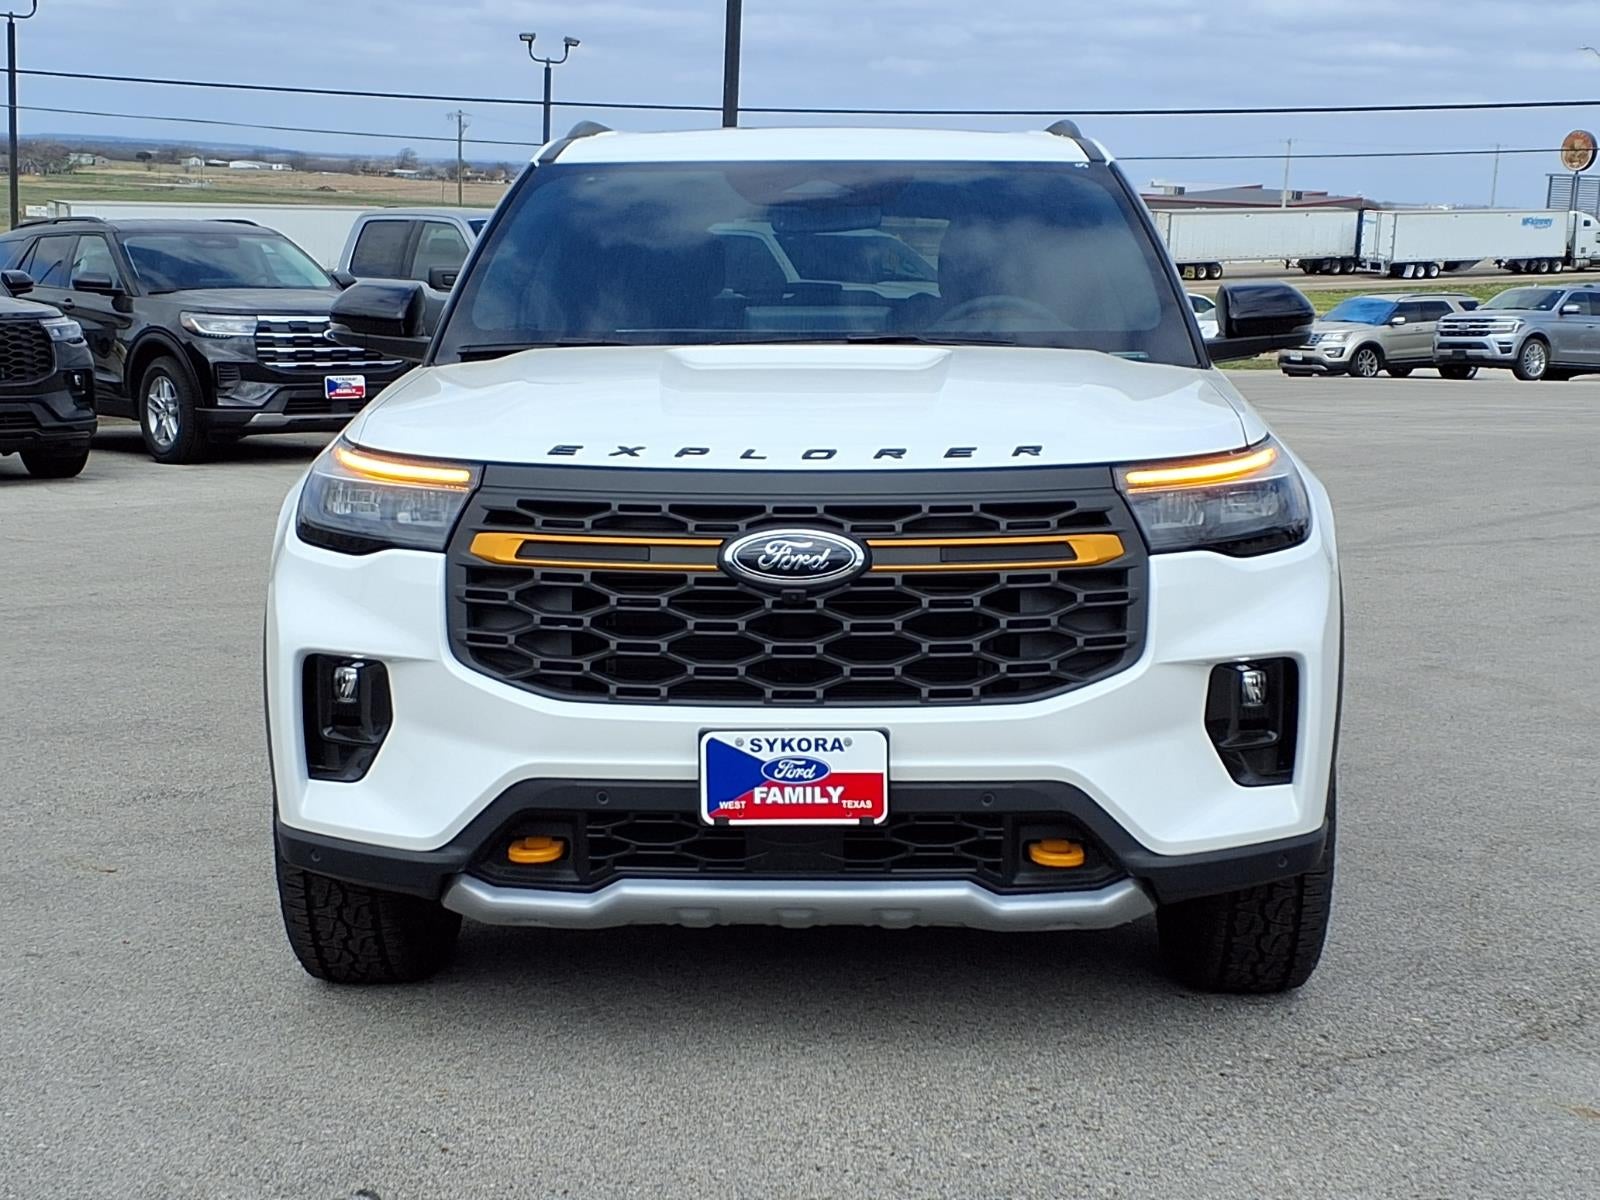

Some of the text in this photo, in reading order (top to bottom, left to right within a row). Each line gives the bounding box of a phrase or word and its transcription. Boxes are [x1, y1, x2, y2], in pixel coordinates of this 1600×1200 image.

[547, 445, 1042, 460] EXPLORER
[758, 540, 831, 570] Ford
[750, 737, 845, 752] SYKORA
[774, 759, 815, 779] Ford
[753, 786, 844, 804] FAMILY
[719, 800, 746, 809] WEST
[842, 799, 872, 808] TEXAS
